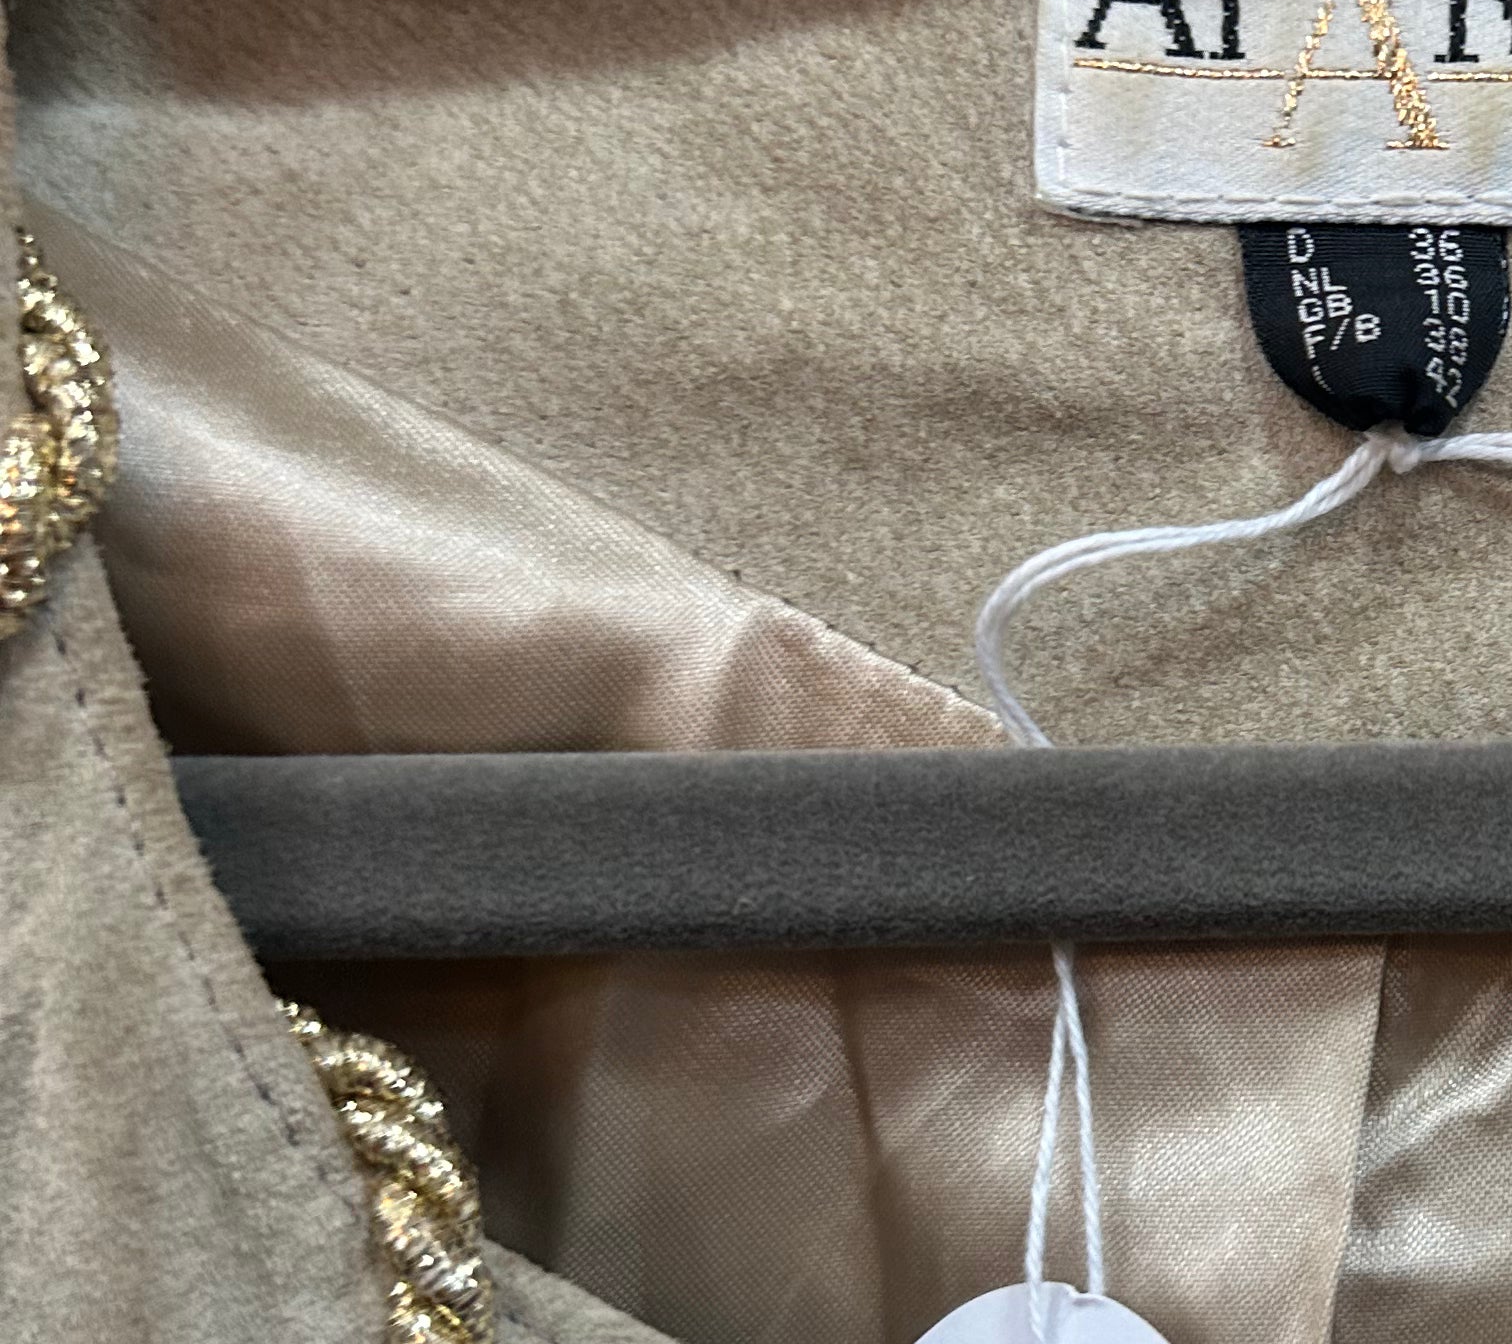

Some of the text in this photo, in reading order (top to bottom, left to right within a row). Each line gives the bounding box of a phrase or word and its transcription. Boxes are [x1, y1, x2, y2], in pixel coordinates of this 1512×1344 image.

[1286, 227, 1464, 264] D 36
[1290, 263, 1469, 297] NL 36
[1297, 289, 1470, 324] GB 10
[1302, 313, 1469, 366] F/B 38
